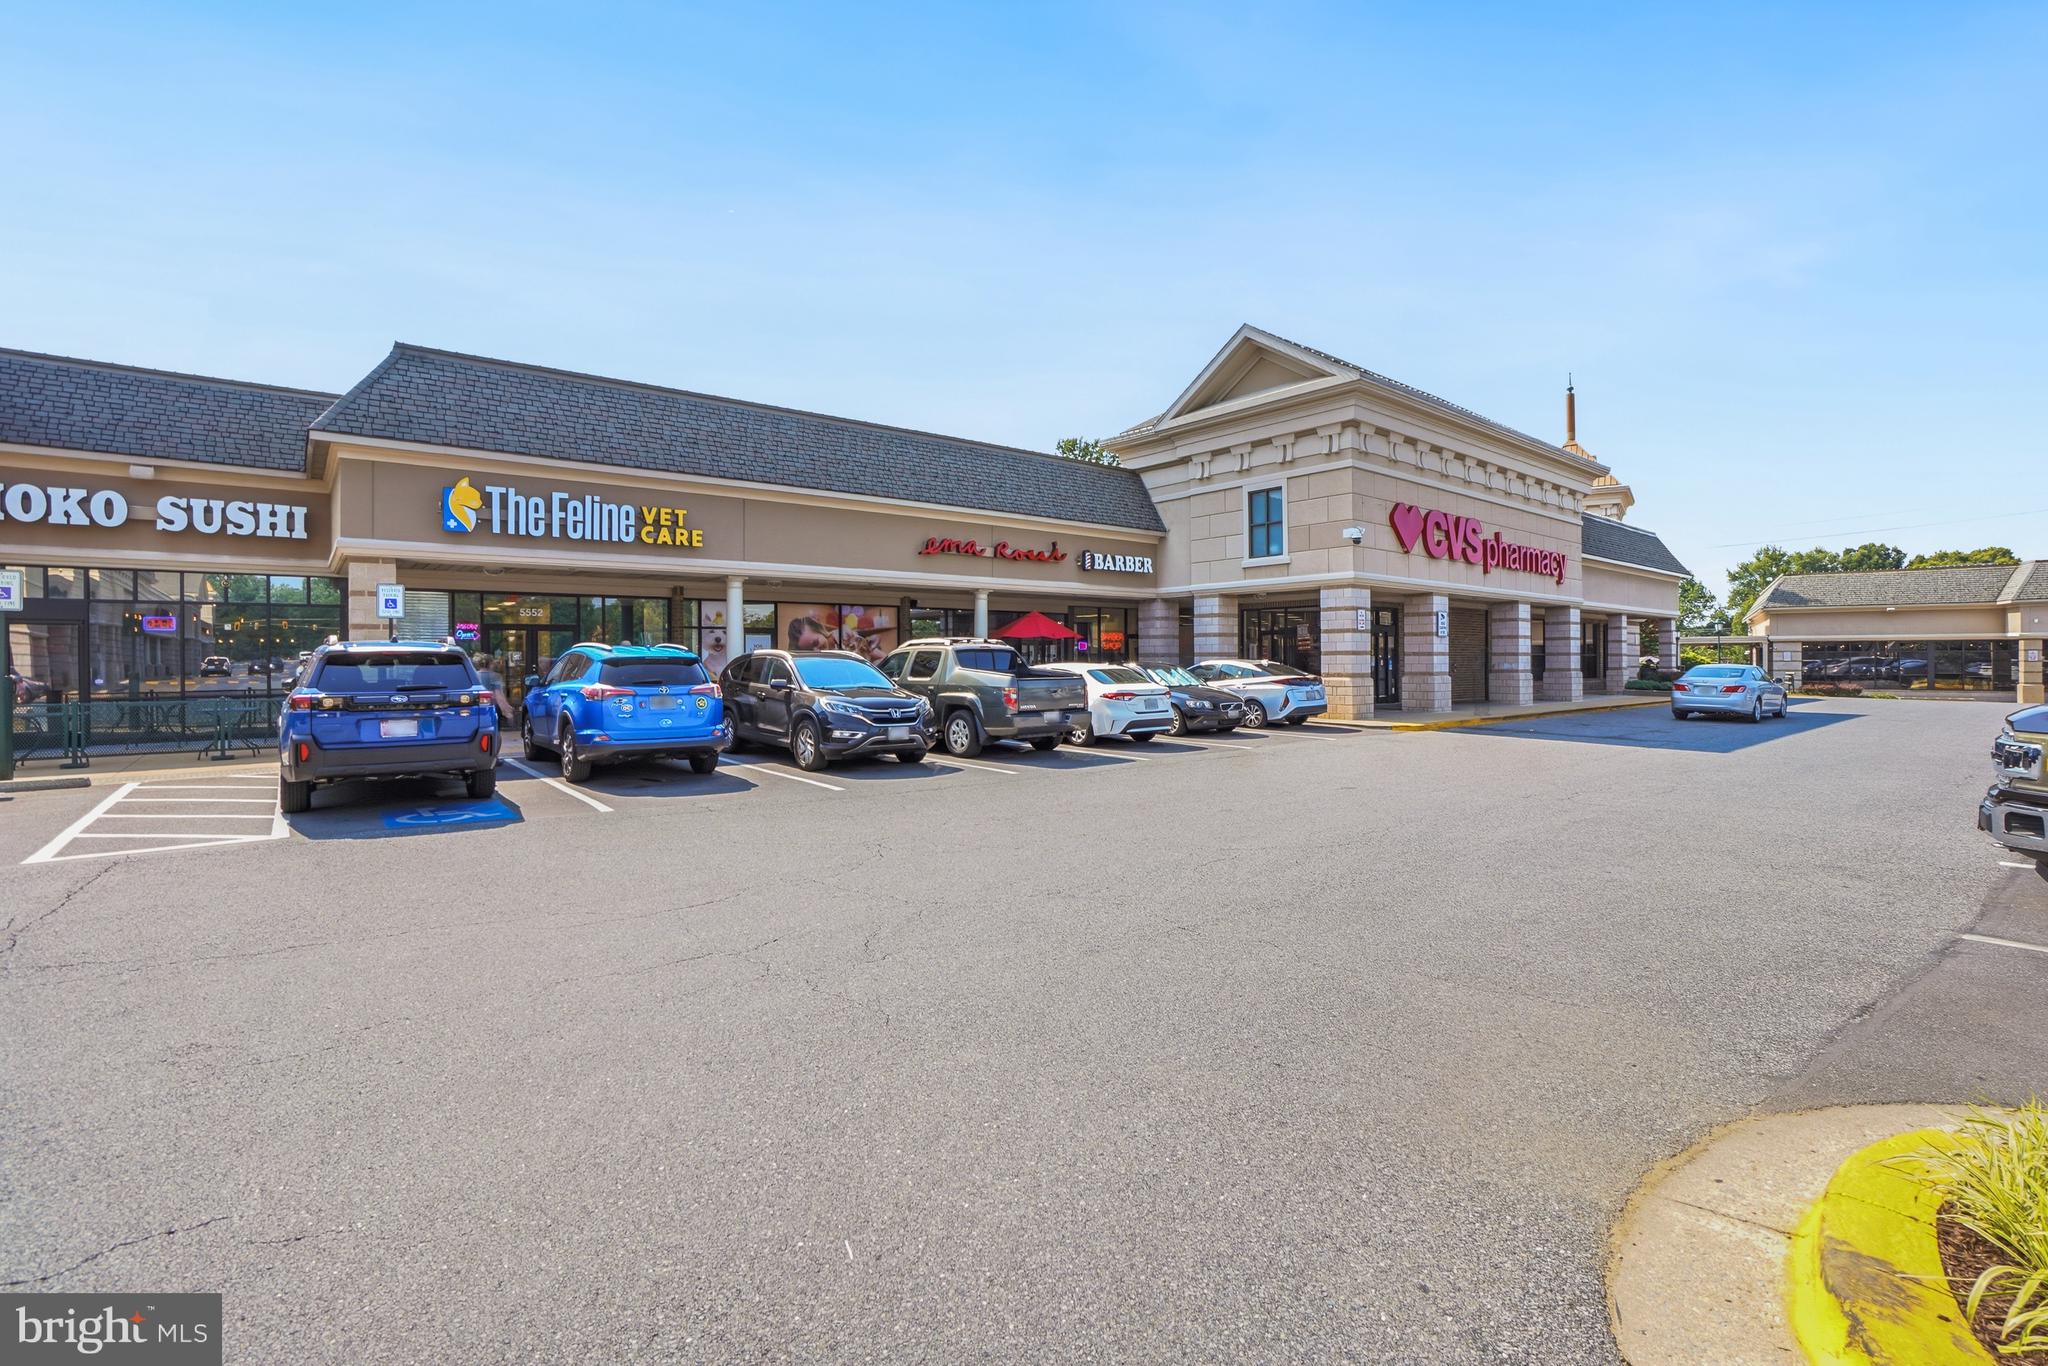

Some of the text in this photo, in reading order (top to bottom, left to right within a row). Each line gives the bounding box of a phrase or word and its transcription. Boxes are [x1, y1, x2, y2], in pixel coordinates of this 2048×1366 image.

[0, 482, 308, 540] OKO SUSHI
[485, 485, 636, 544] The Feline
[640, 505, 688, 528] VET
[639, 526, 704, 548] CARE
[1422, 509, 1568, 586] CVS pharmacy
[1093, 553, 1153, 574] BARBER
[519, 608, 544, 617] 5552
